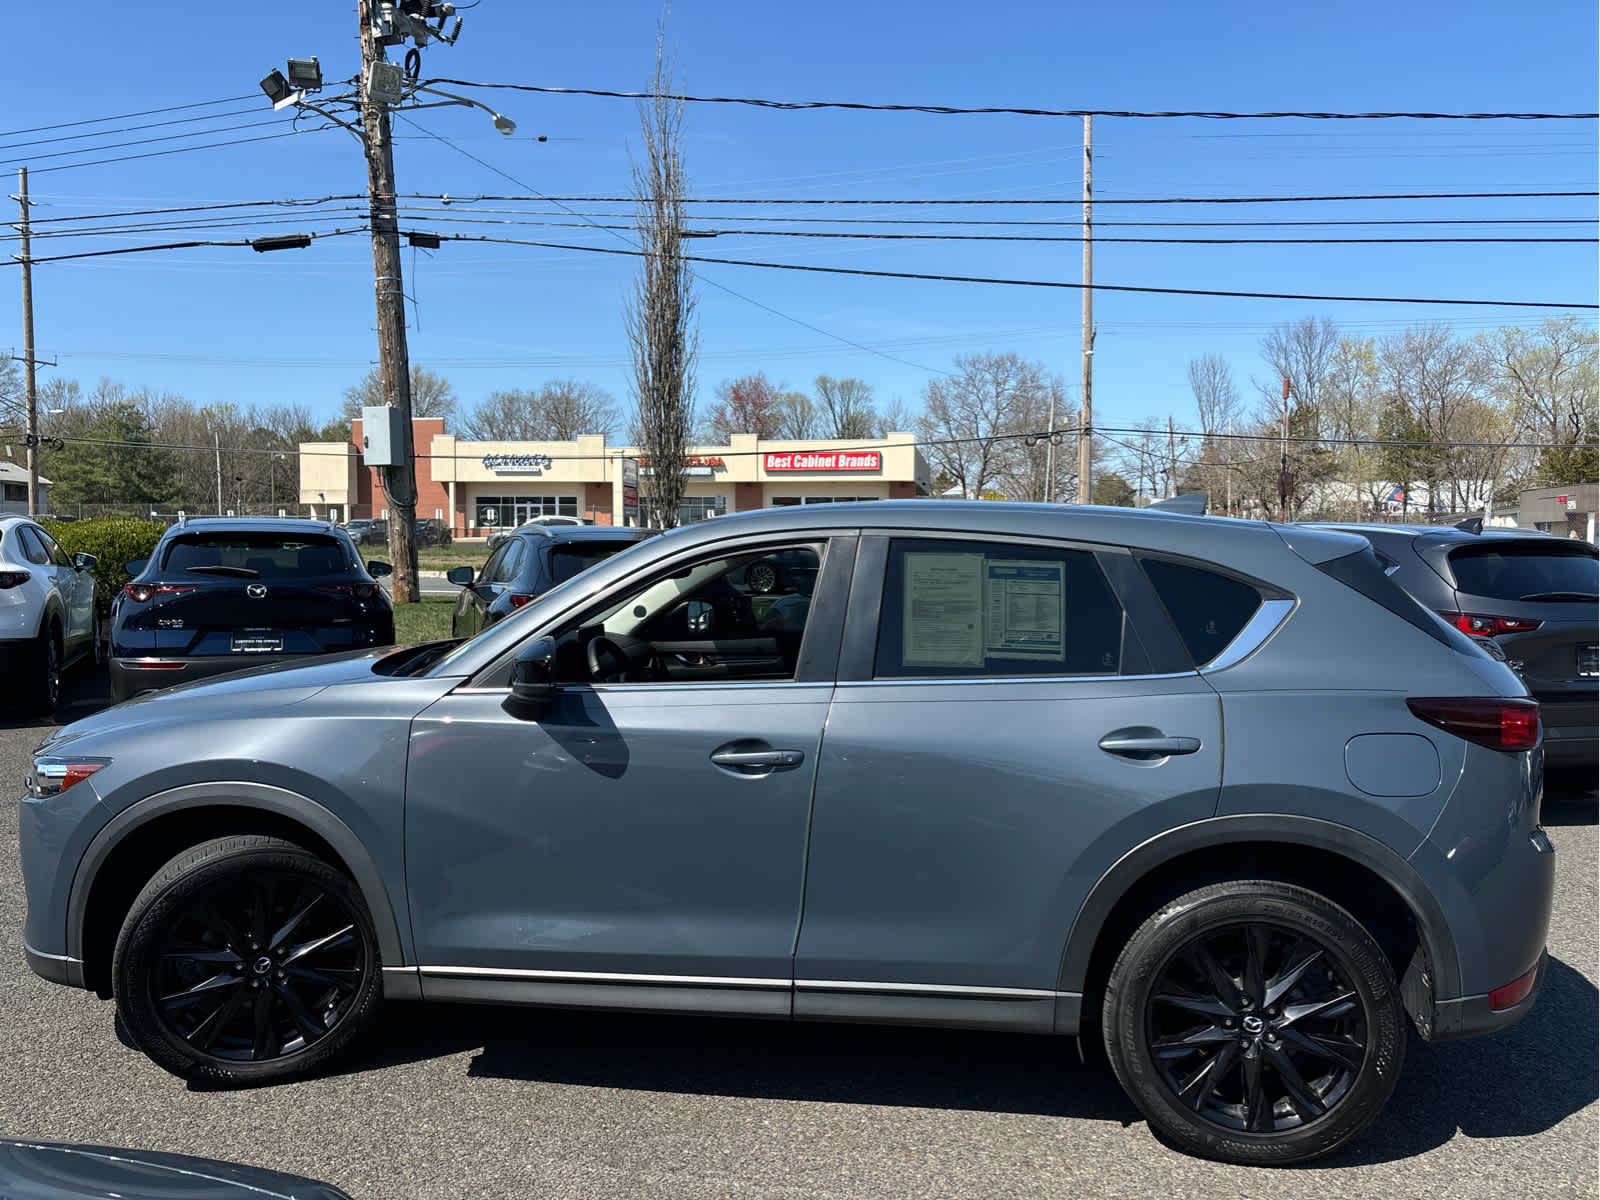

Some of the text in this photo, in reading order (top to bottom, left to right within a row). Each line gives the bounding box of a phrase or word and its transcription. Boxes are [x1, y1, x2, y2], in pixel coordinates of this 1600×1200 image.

[767, 453, 877, 468] Best Cabinet Brands
